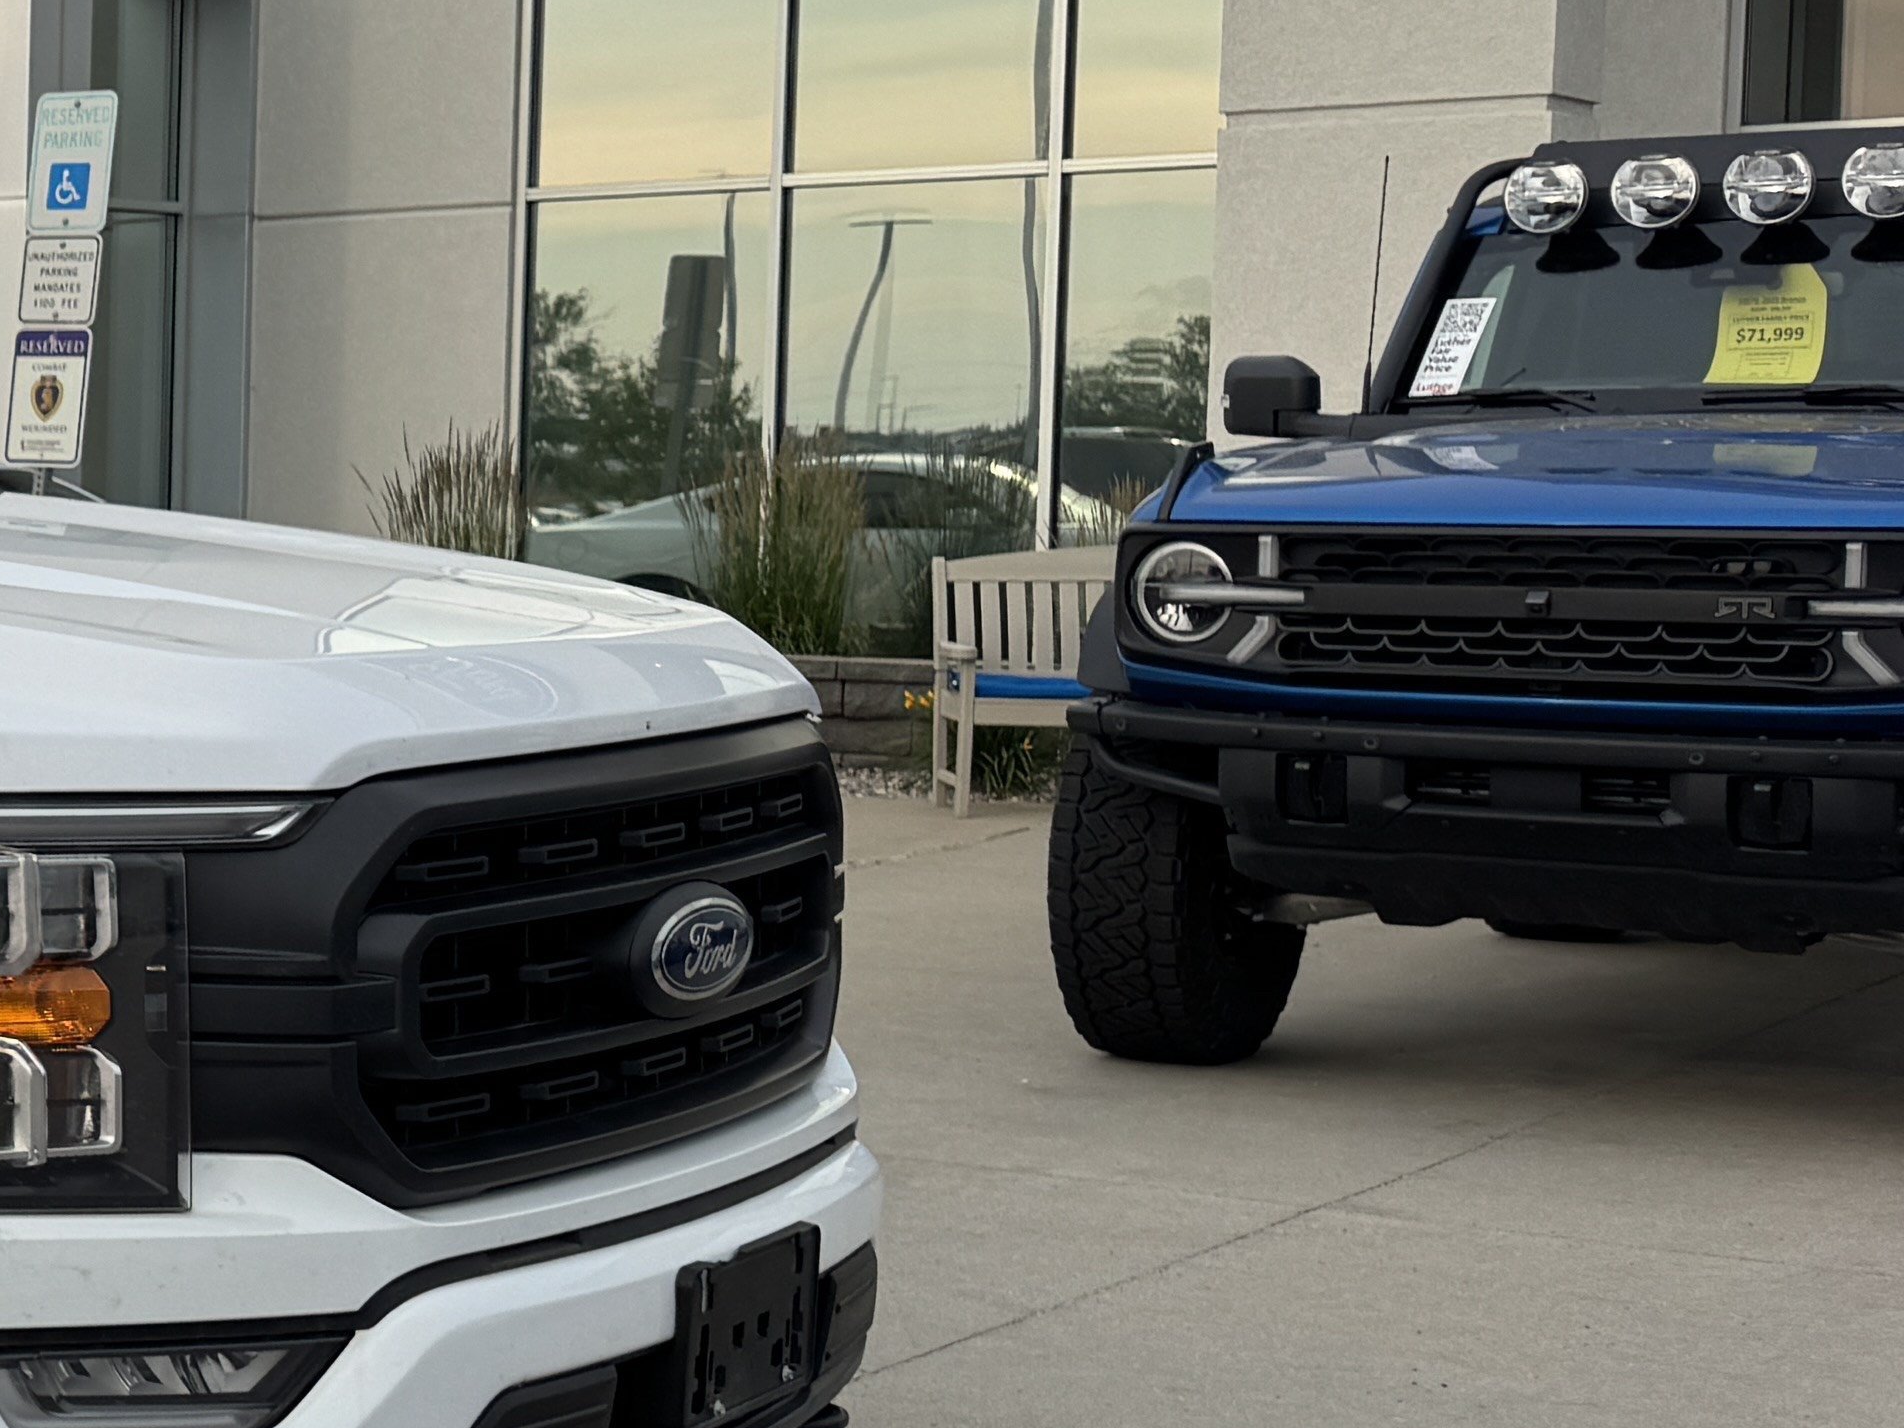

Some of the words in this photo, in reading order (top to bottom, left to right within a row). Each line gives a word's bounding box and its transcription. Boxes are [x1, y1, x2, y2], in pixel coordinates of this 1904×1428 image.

[41, 106, 111, 126] RESERVED
[44, 130, 103, 149] PARKING
[28, 251, 94, 262] UNAUTHORIZED
[40, 267, 78, 277] PARKING
[33, 283, 81, 293] MANDATES
[62, 298, 78, 309] FEE
[1736, 327, 1805, 344] $71,999
[20, 339, 85, 355] RESERVED
[684, 920, 738, 979] Ford
